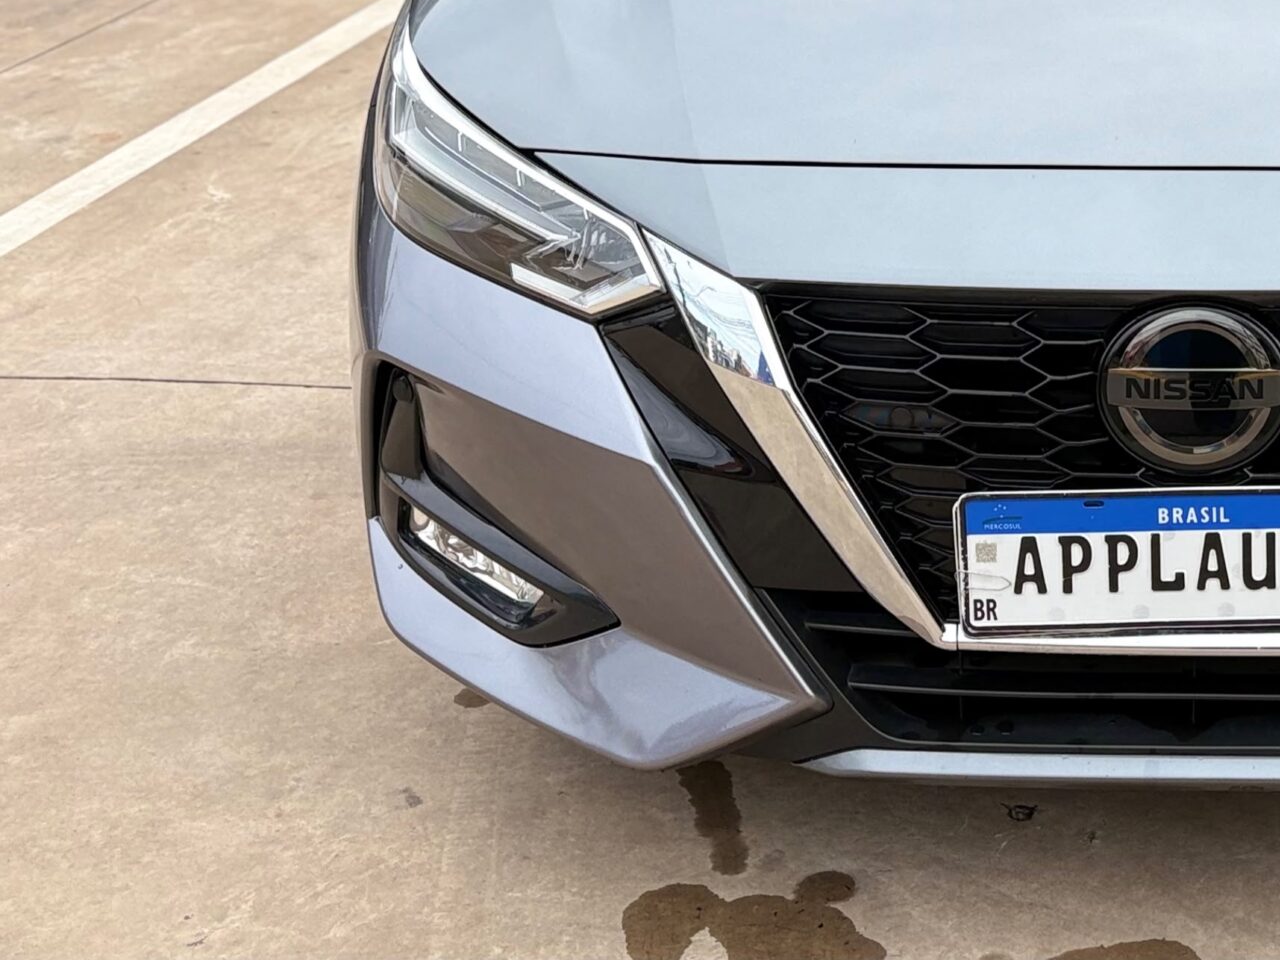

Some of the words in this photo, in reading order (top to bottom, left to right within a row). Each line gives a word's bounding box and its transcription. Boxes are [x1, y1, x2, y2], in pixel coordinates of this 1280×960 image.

[1125, 377, 1264, 401] NISSAN
[1157, 506, 1231, 525] BRASIL
[983, 523, 1022, 531] MERCOSUL
[972, 598, 998, 621] BR
